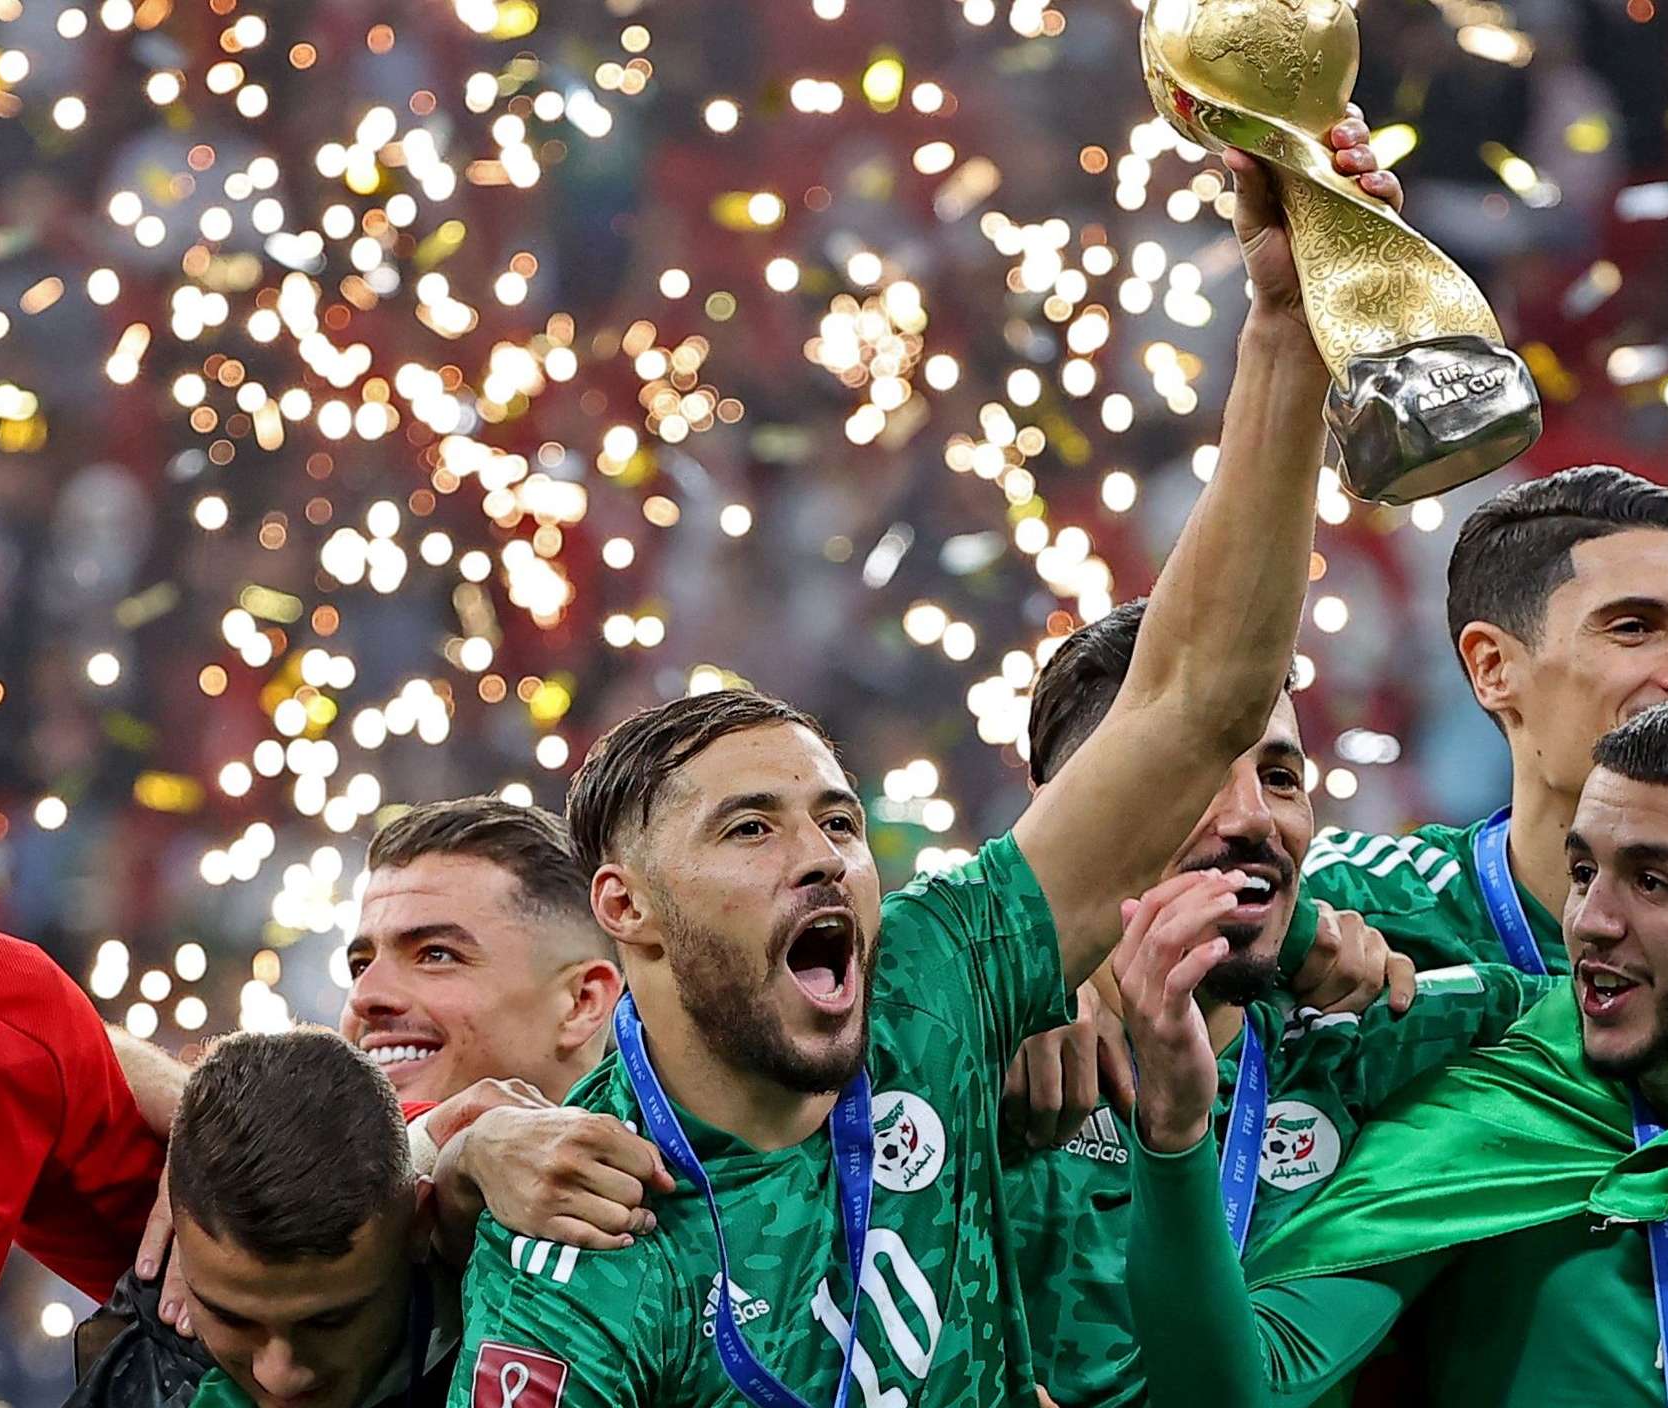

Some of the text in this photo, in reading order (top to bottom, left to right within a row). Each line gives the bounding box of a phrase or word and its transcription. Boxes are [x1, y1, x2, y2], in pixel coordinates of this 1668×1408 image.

[1431, 363, 1472, 386] FIFA
[1469, 368, 1506, 392] CUP
[1249, 1060, 1261, 1091] FIFA
[1242, 1105, 1255, 1136] FIFA
[1062, 1134, 1128, 1164] didas
[1234, 1151, 1248, 1183] FIFA
[703, 1297, 770, 1337] adas
